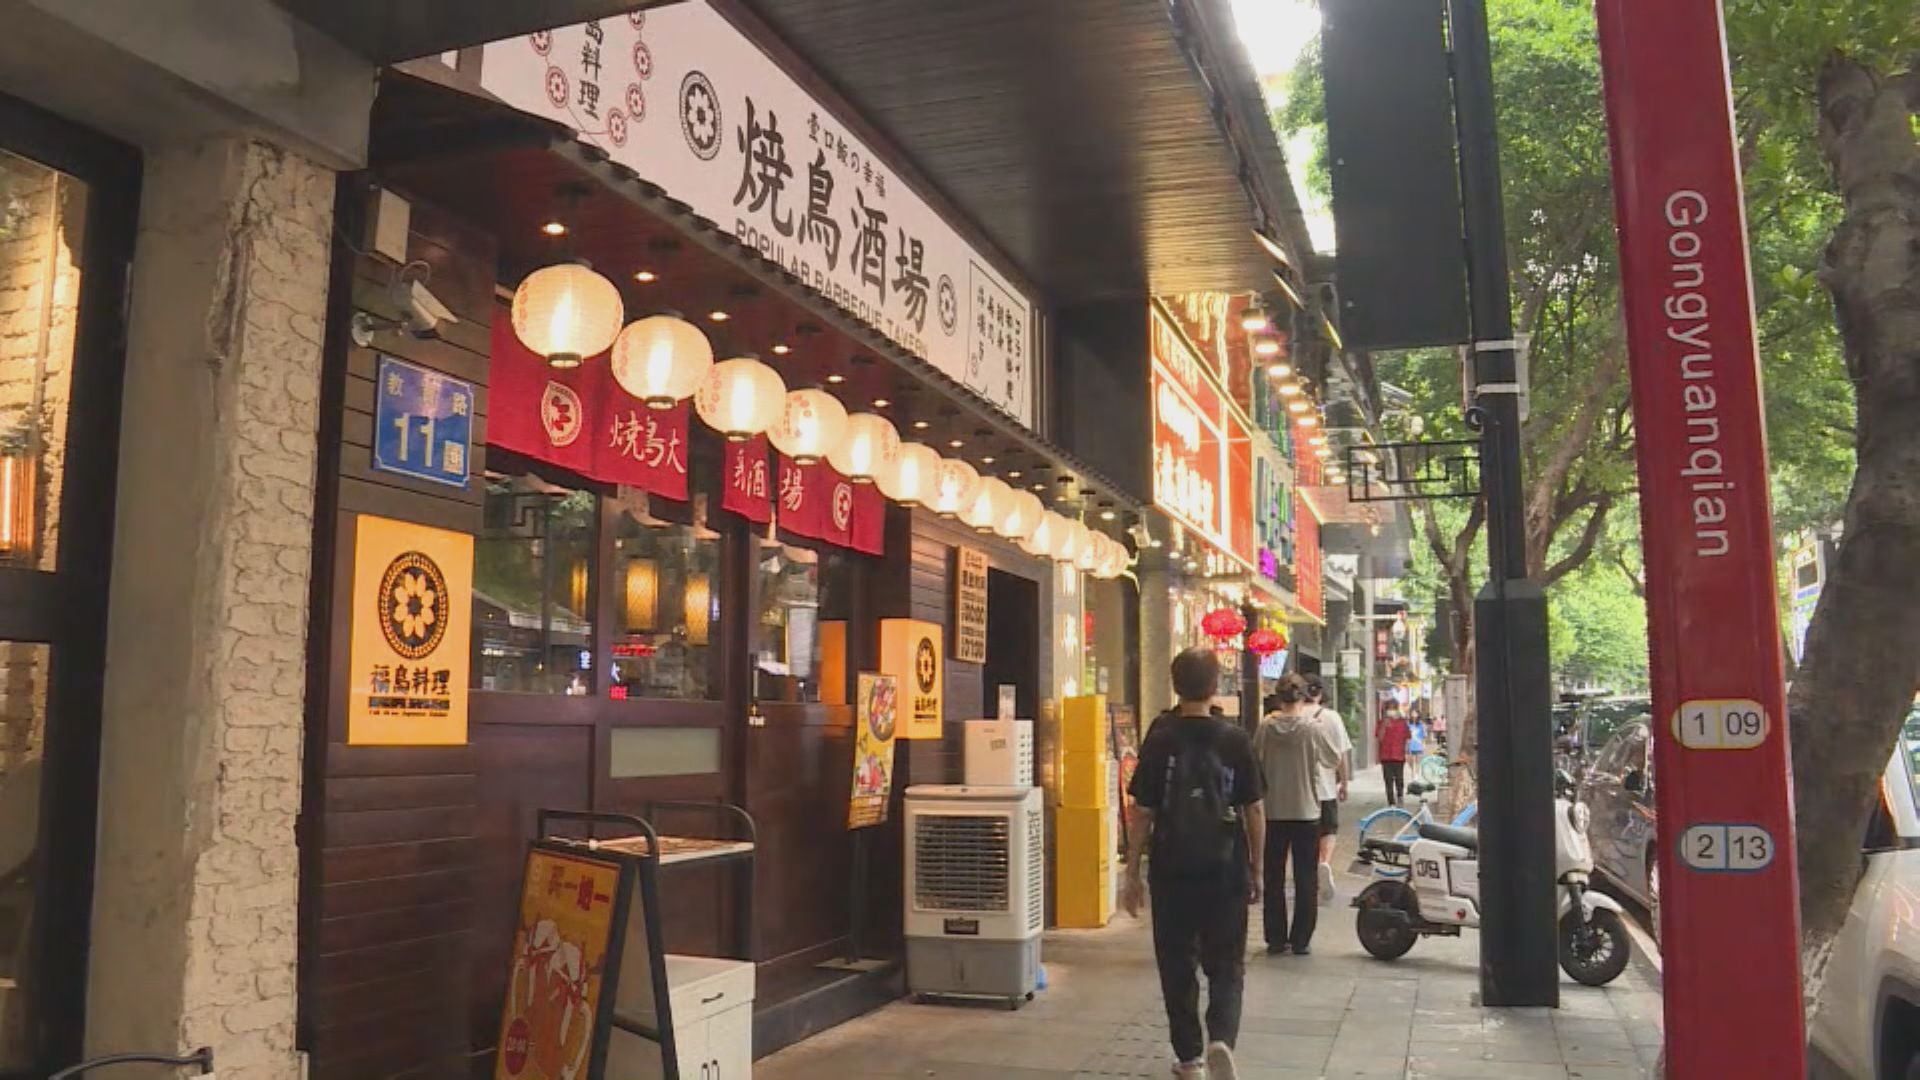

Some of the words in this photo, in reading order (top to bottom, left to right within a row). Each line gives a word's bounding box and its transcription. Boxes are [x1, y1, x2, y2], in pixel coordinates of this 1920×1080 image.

[733, 96, 930, 334] 焼鳥酒場
[1664, 189, 1734, 557] Gongyuanqian
[394, 413, 434, 467] 11
[370, 664, 450, 695] 福島料理
[1693, 712, 1705, 735] 1
[1726, 712, 1760, 735] 09
[1697, 834, 1714, 859] 2
[1733, 836, 1767, 860] 13
